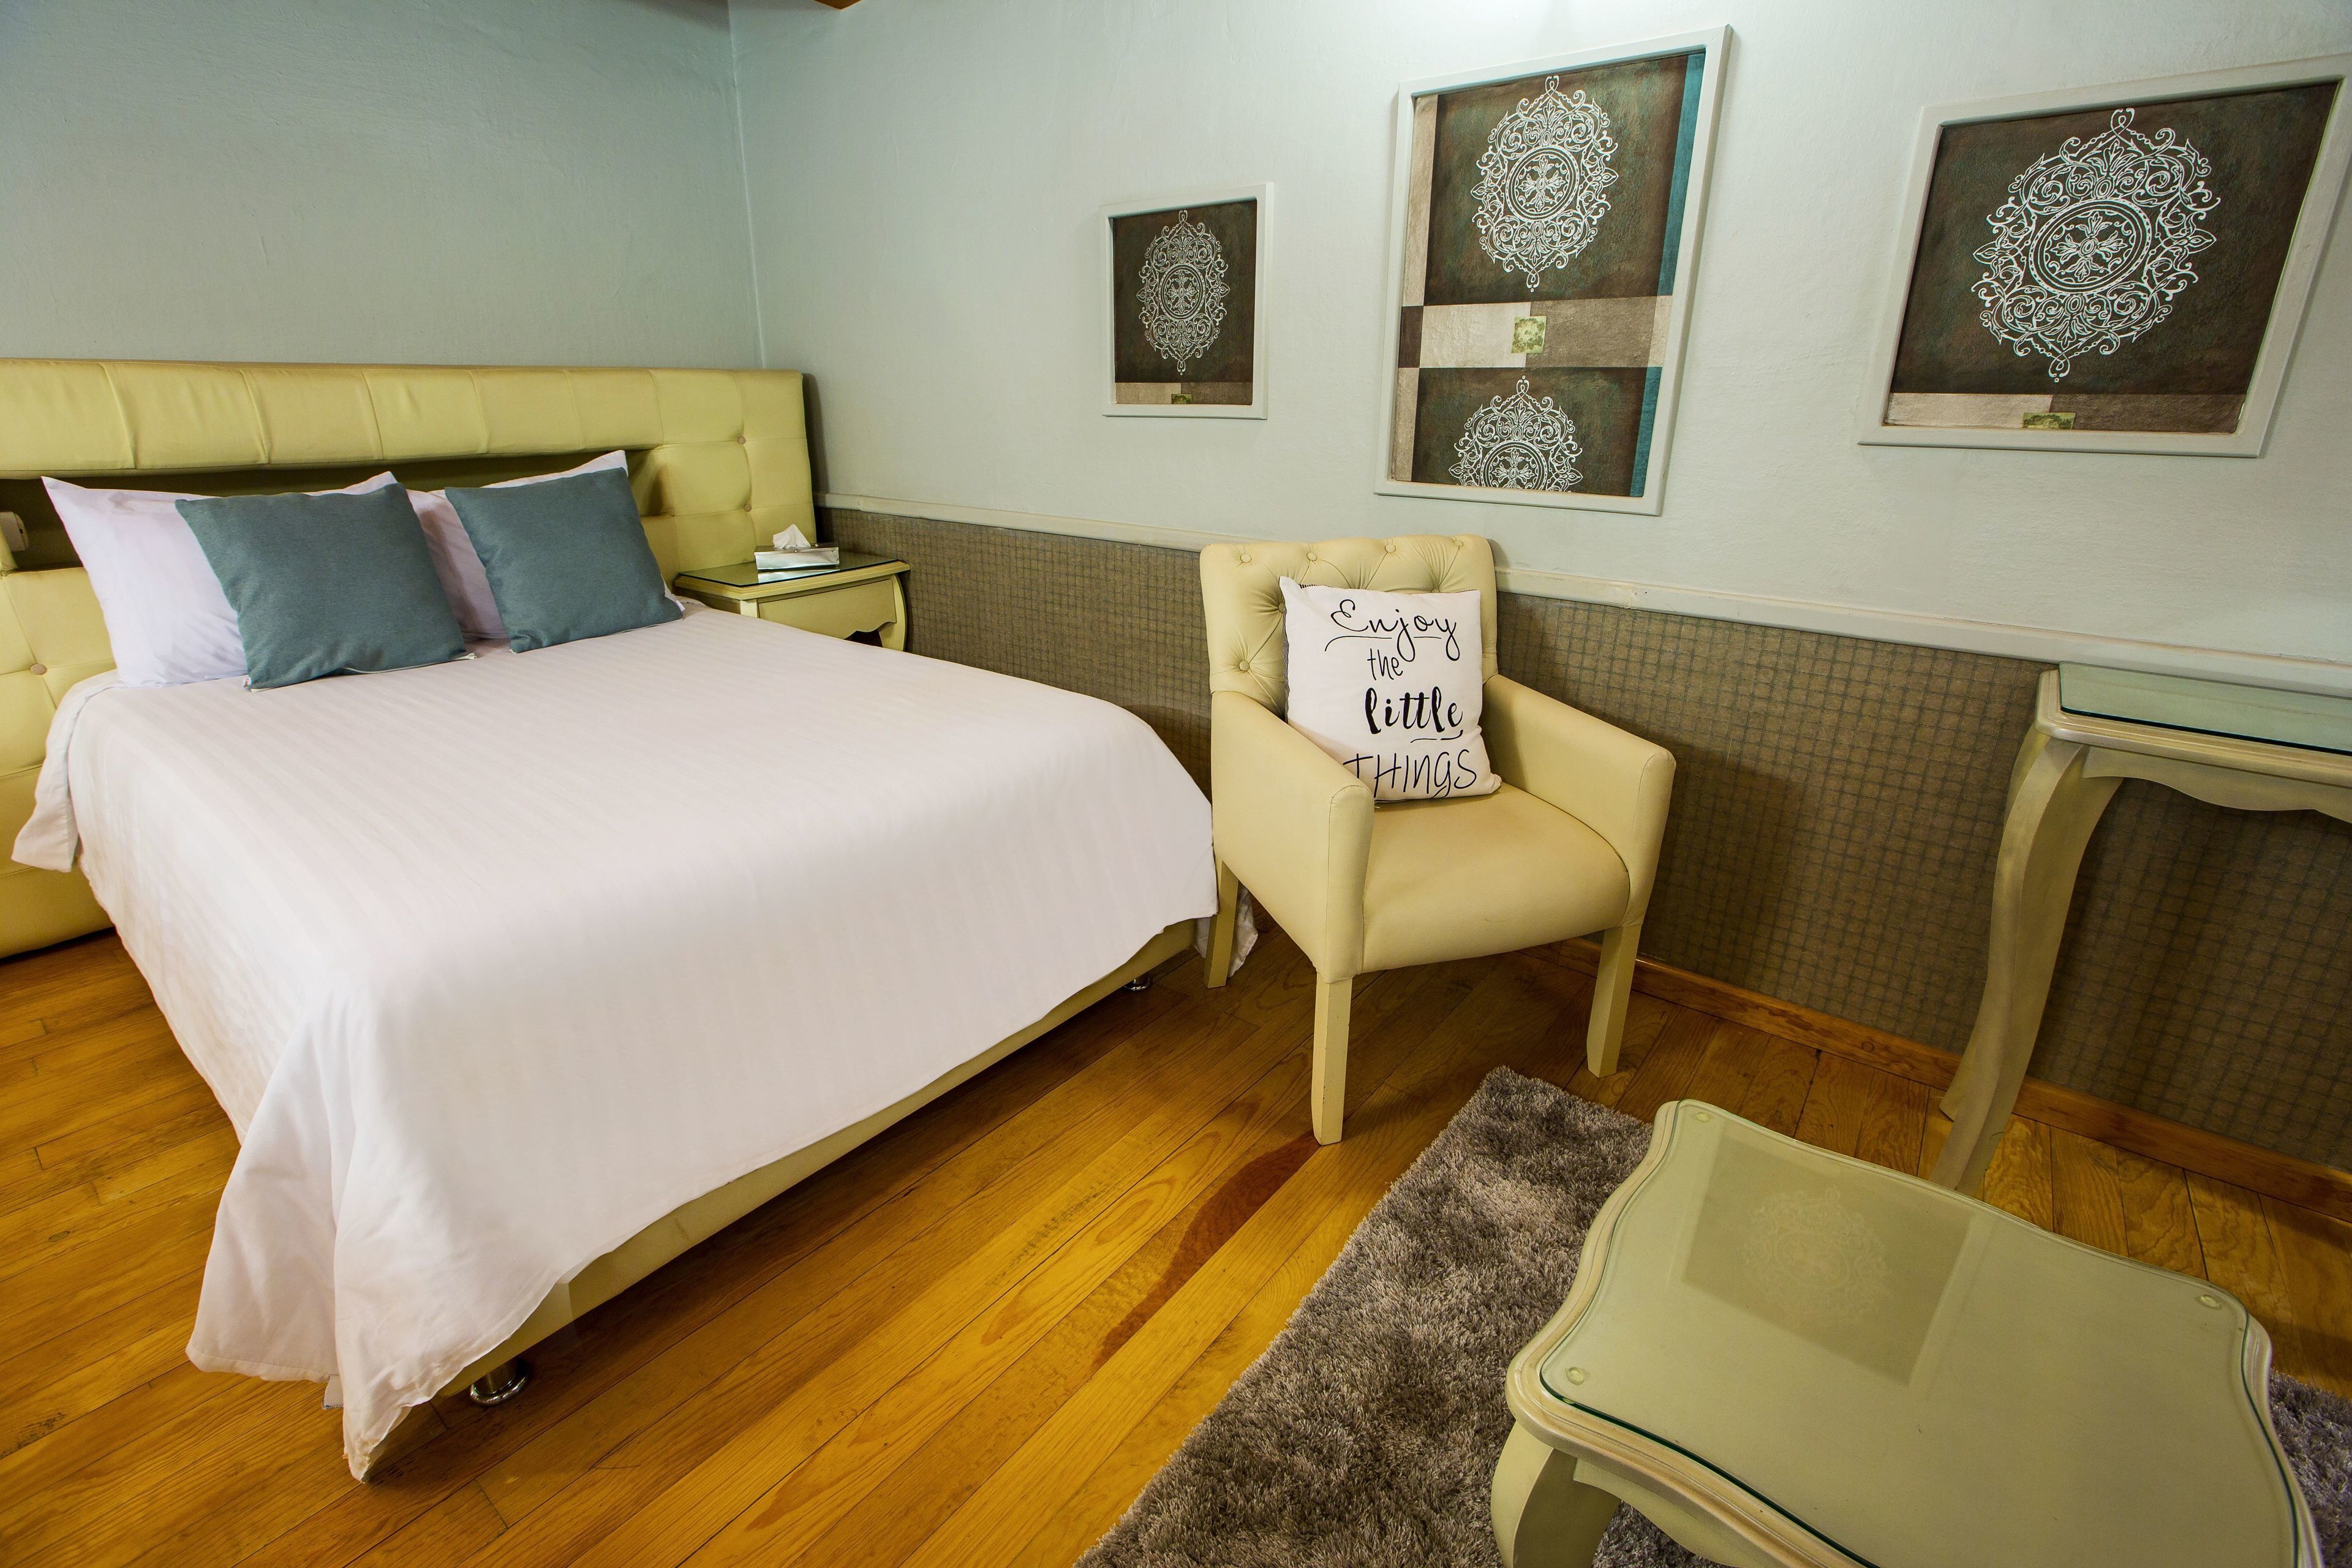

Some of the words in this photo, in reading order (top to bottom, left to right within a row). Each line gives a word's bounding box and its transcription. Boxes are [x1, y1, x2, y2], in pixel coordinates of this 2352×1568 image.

[1330, 599, 1460, 662] Enjoy
[1367, 648, 1404, 681] the
[1365, 686, 1463, 734] little
